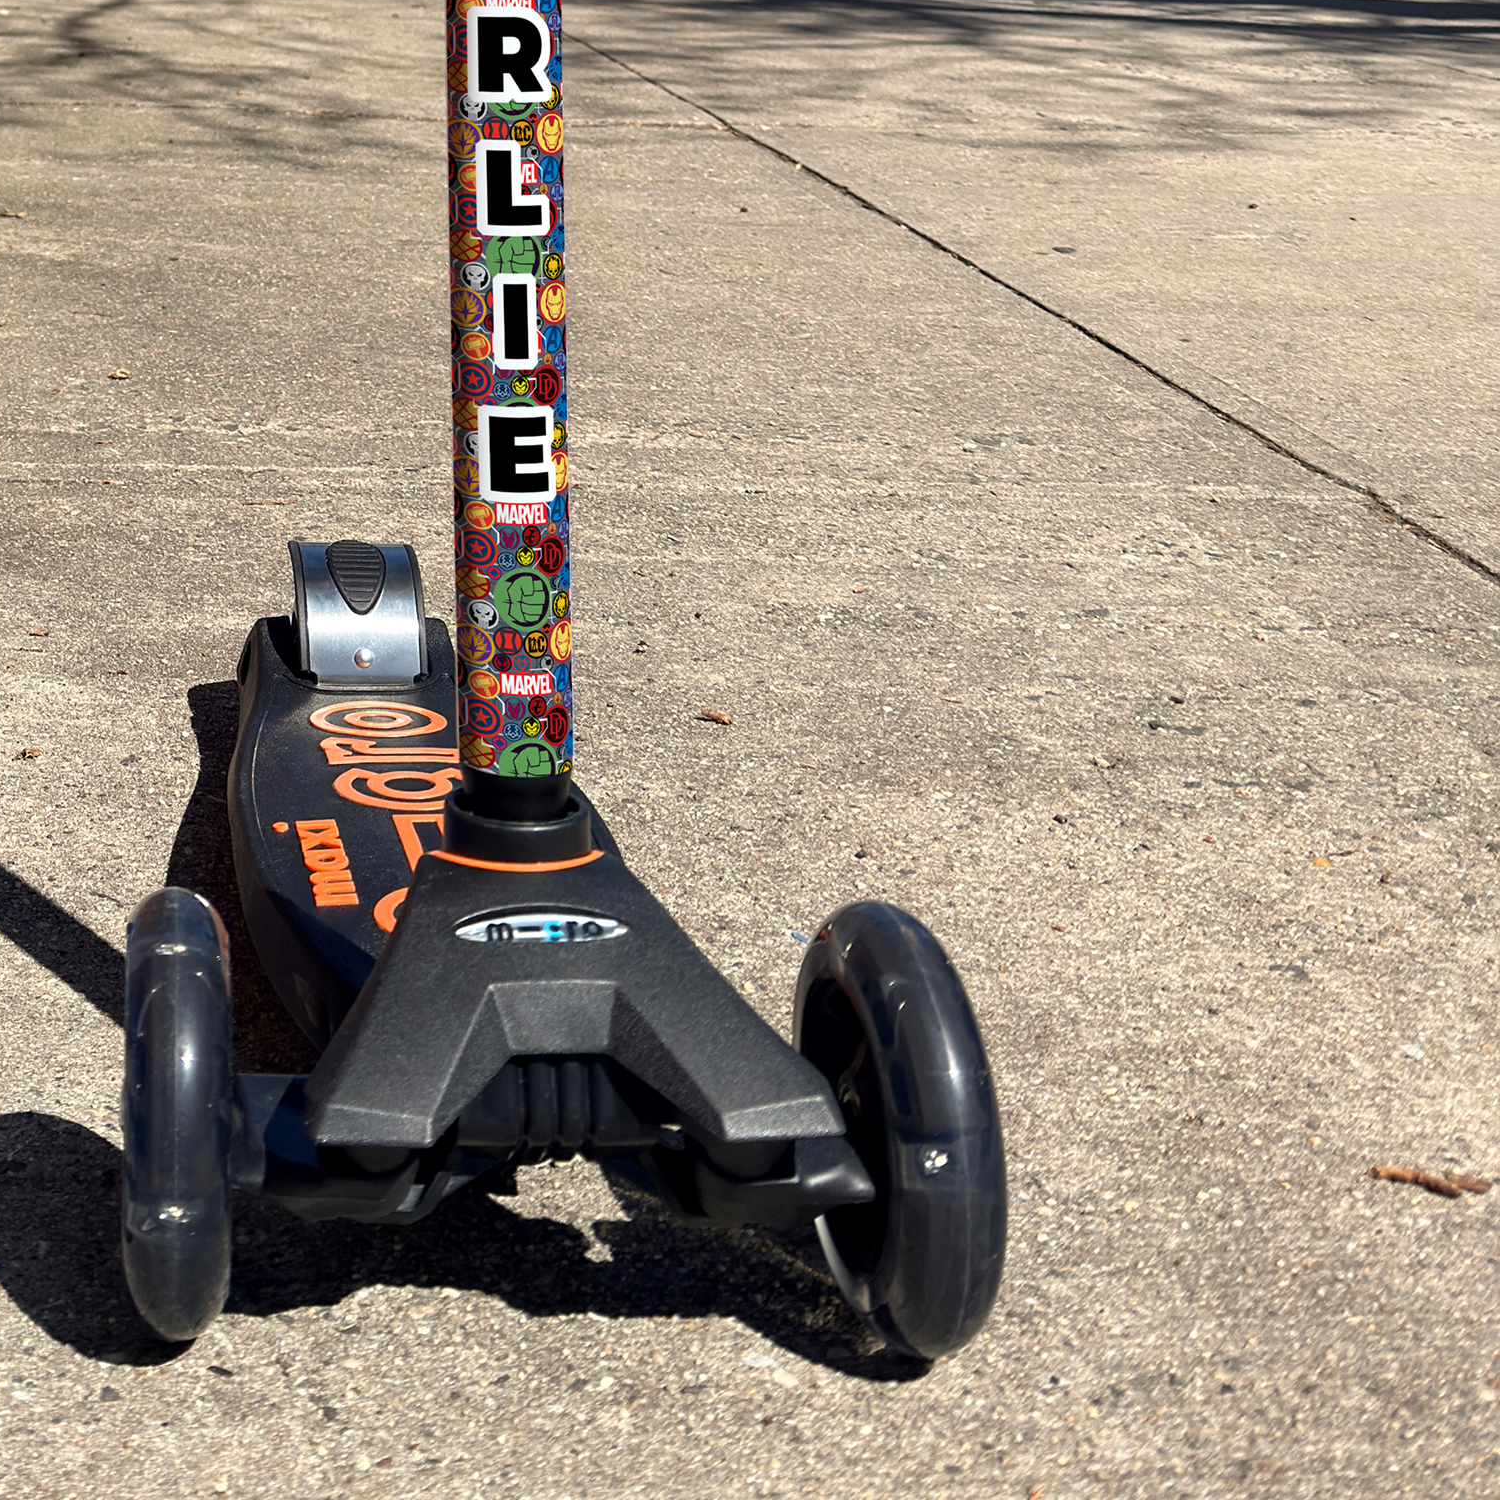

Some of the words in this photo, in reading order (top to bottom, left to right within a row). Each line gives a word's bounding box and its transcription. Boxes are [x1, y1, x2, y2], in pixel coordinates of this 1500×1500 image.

[496, 503, 547, 524] MARVEL
[501, 673, 552, 695] MARVEL
[272, 819, 359, 907] maxi
